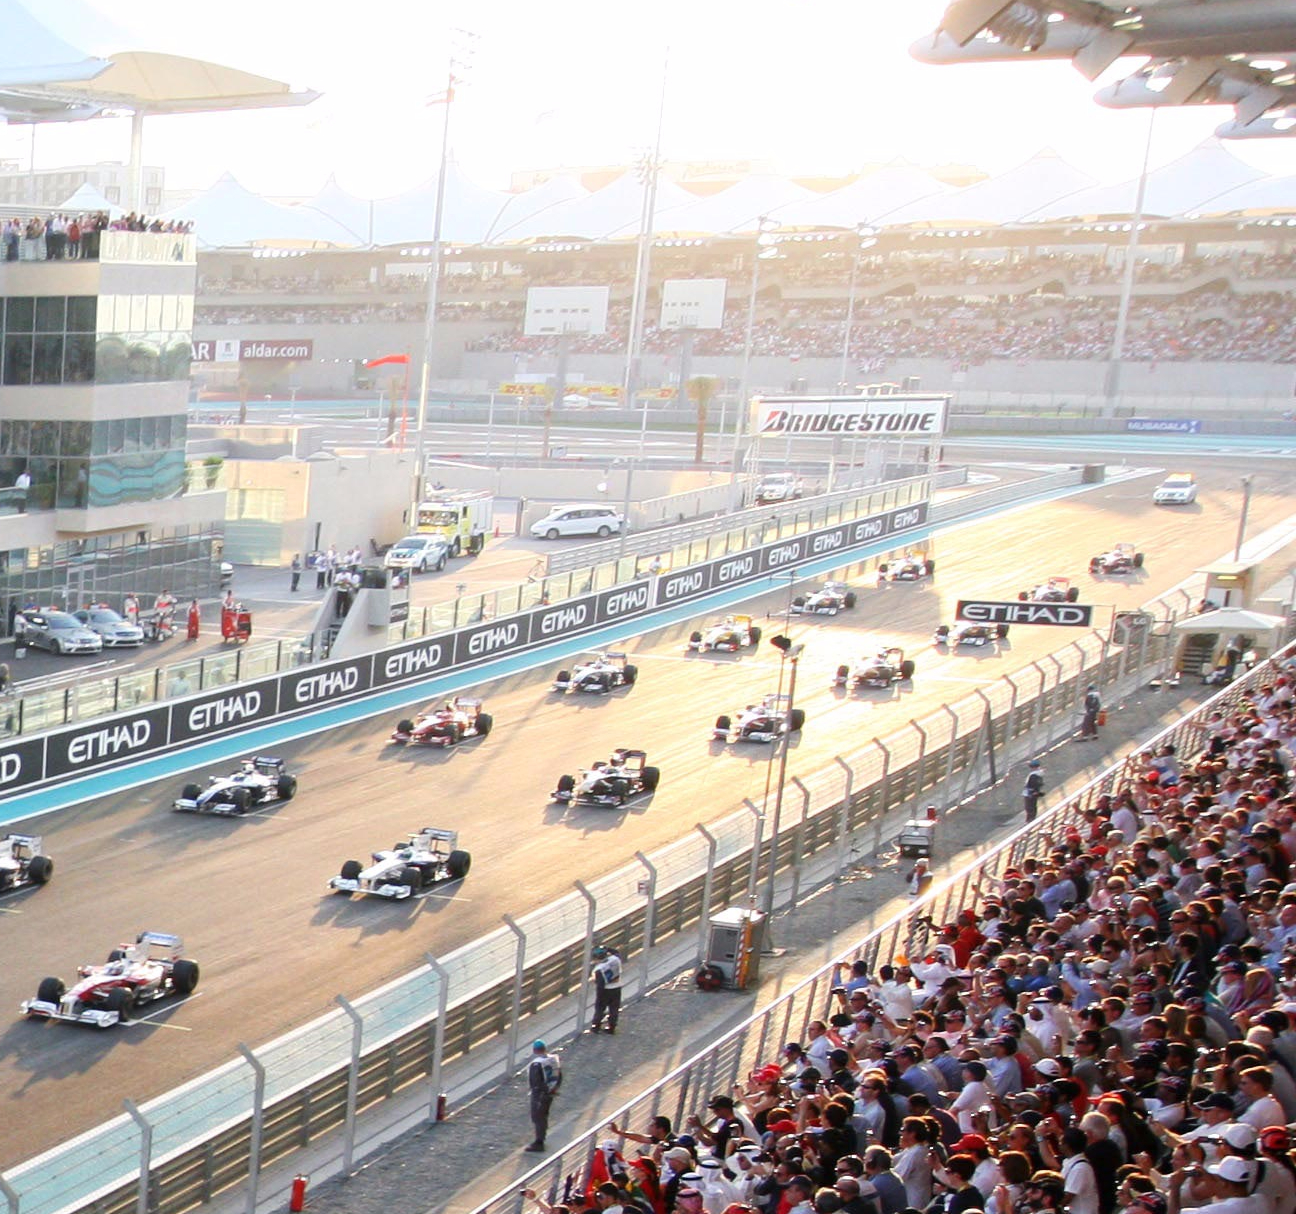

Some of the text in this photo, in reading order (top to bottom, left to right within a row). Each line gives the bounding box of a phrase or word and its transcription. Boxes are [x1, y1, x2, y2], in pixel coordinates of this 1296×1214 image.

[244, 343, 308, 358] aldar.com
[759, 410, 936, 433] BRIDGESTONE
[814, 531, 842, 552] ETIHAD
[856, 520, 882, 540] ETIHAD
[769, 543, 800, 565] ETIHAD
[719, 557, 752, 580] ETIHAD
[666, 572, 702, 598] ETIHAD
[607, 587, 647, 614] ETIHAD
[962, 604, 1084, 623] ETIHAD
[542, 605, 586, 633] ETIHAD
[469, 624, 518, 654] ETIHAD
[386, 645, 441, 677] ETIHAD
[296, 667, 358, 702] ETIHAD
[189, 691, 260, 730] ETIHAD
[68, 720, 150, 763] ETIHAD
